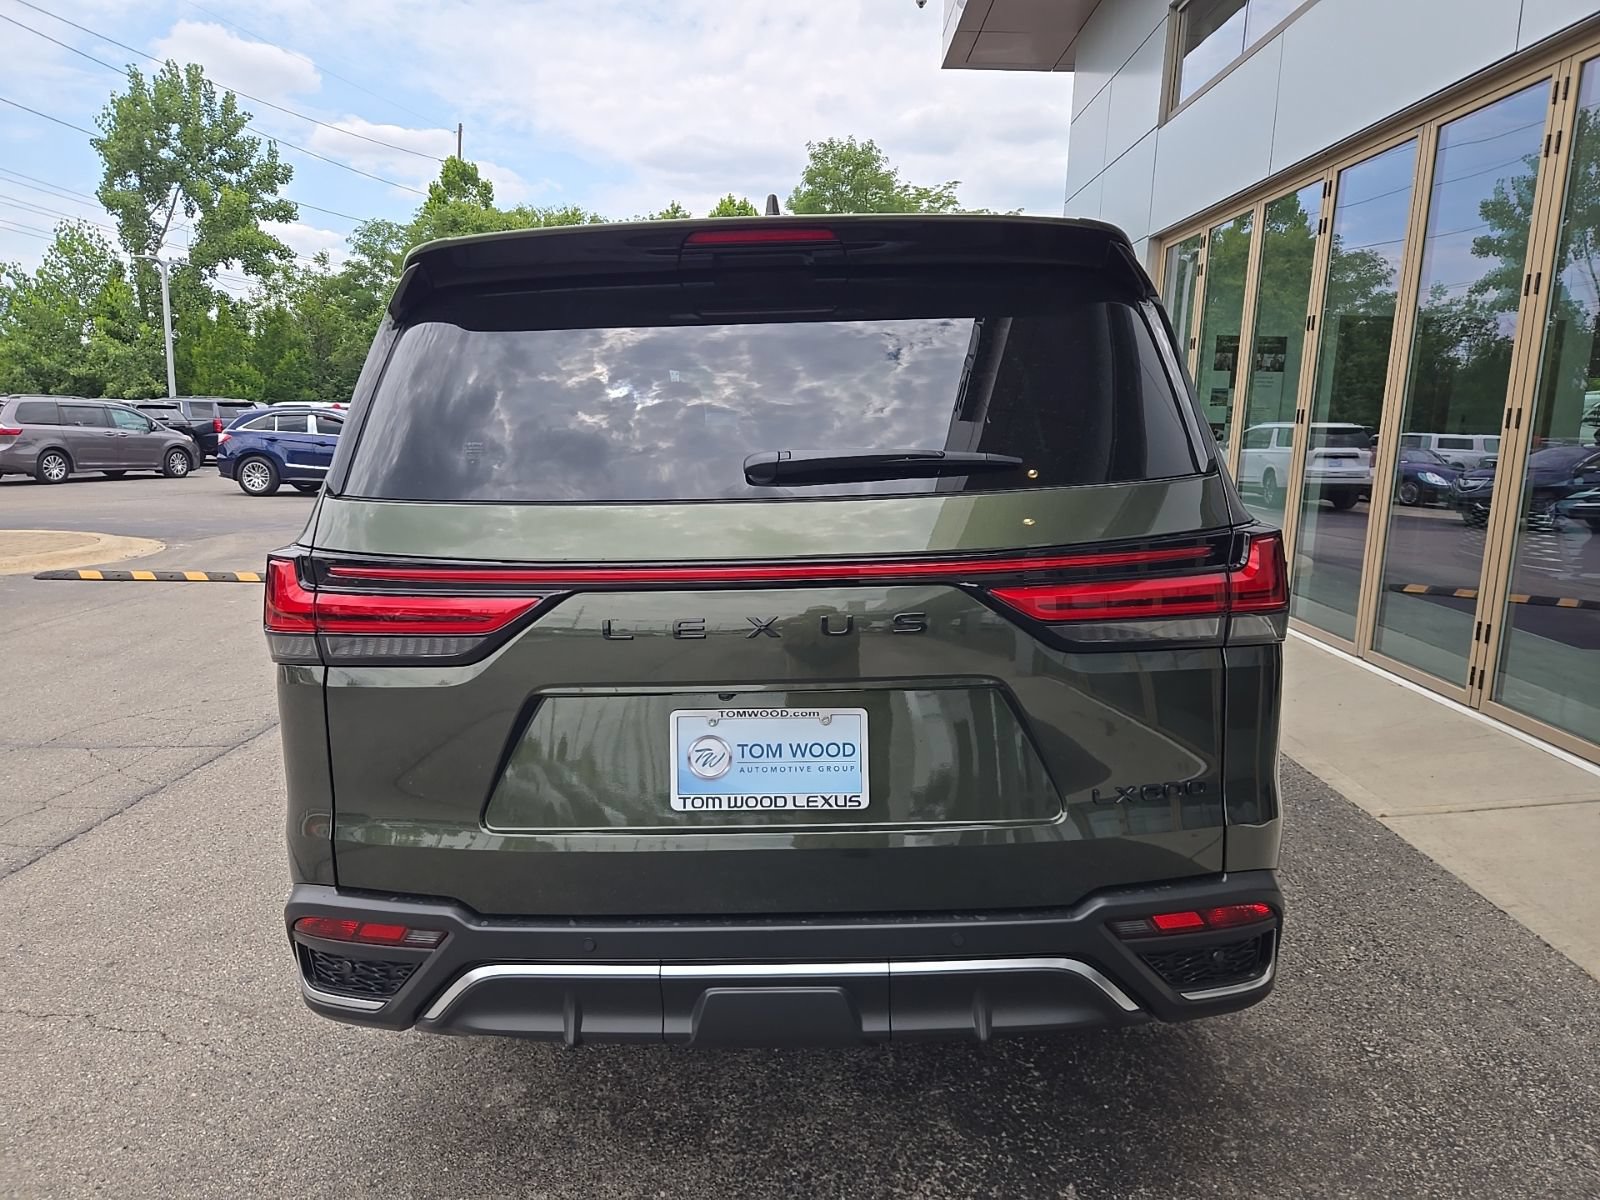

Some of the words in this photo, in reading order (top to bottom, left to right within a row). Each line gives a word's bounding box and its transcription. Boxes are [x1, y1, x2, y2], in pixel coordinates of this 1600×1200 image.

[602, 612, 928, 640] LEXUS
[718, 710, 820, 718] TOMWOOD.com
[737, 743, 782, 758] TOM
[789, 742, 856, 758] WOOD
[739, 765, 812, 773] AUTOMOTIVE
[818, 765, 855, 773] GROUP
[678, 797, 723, 809] TOM
[728, 796, 787, 808] WOOD
[793, 795, 861, 808] LEXUS
